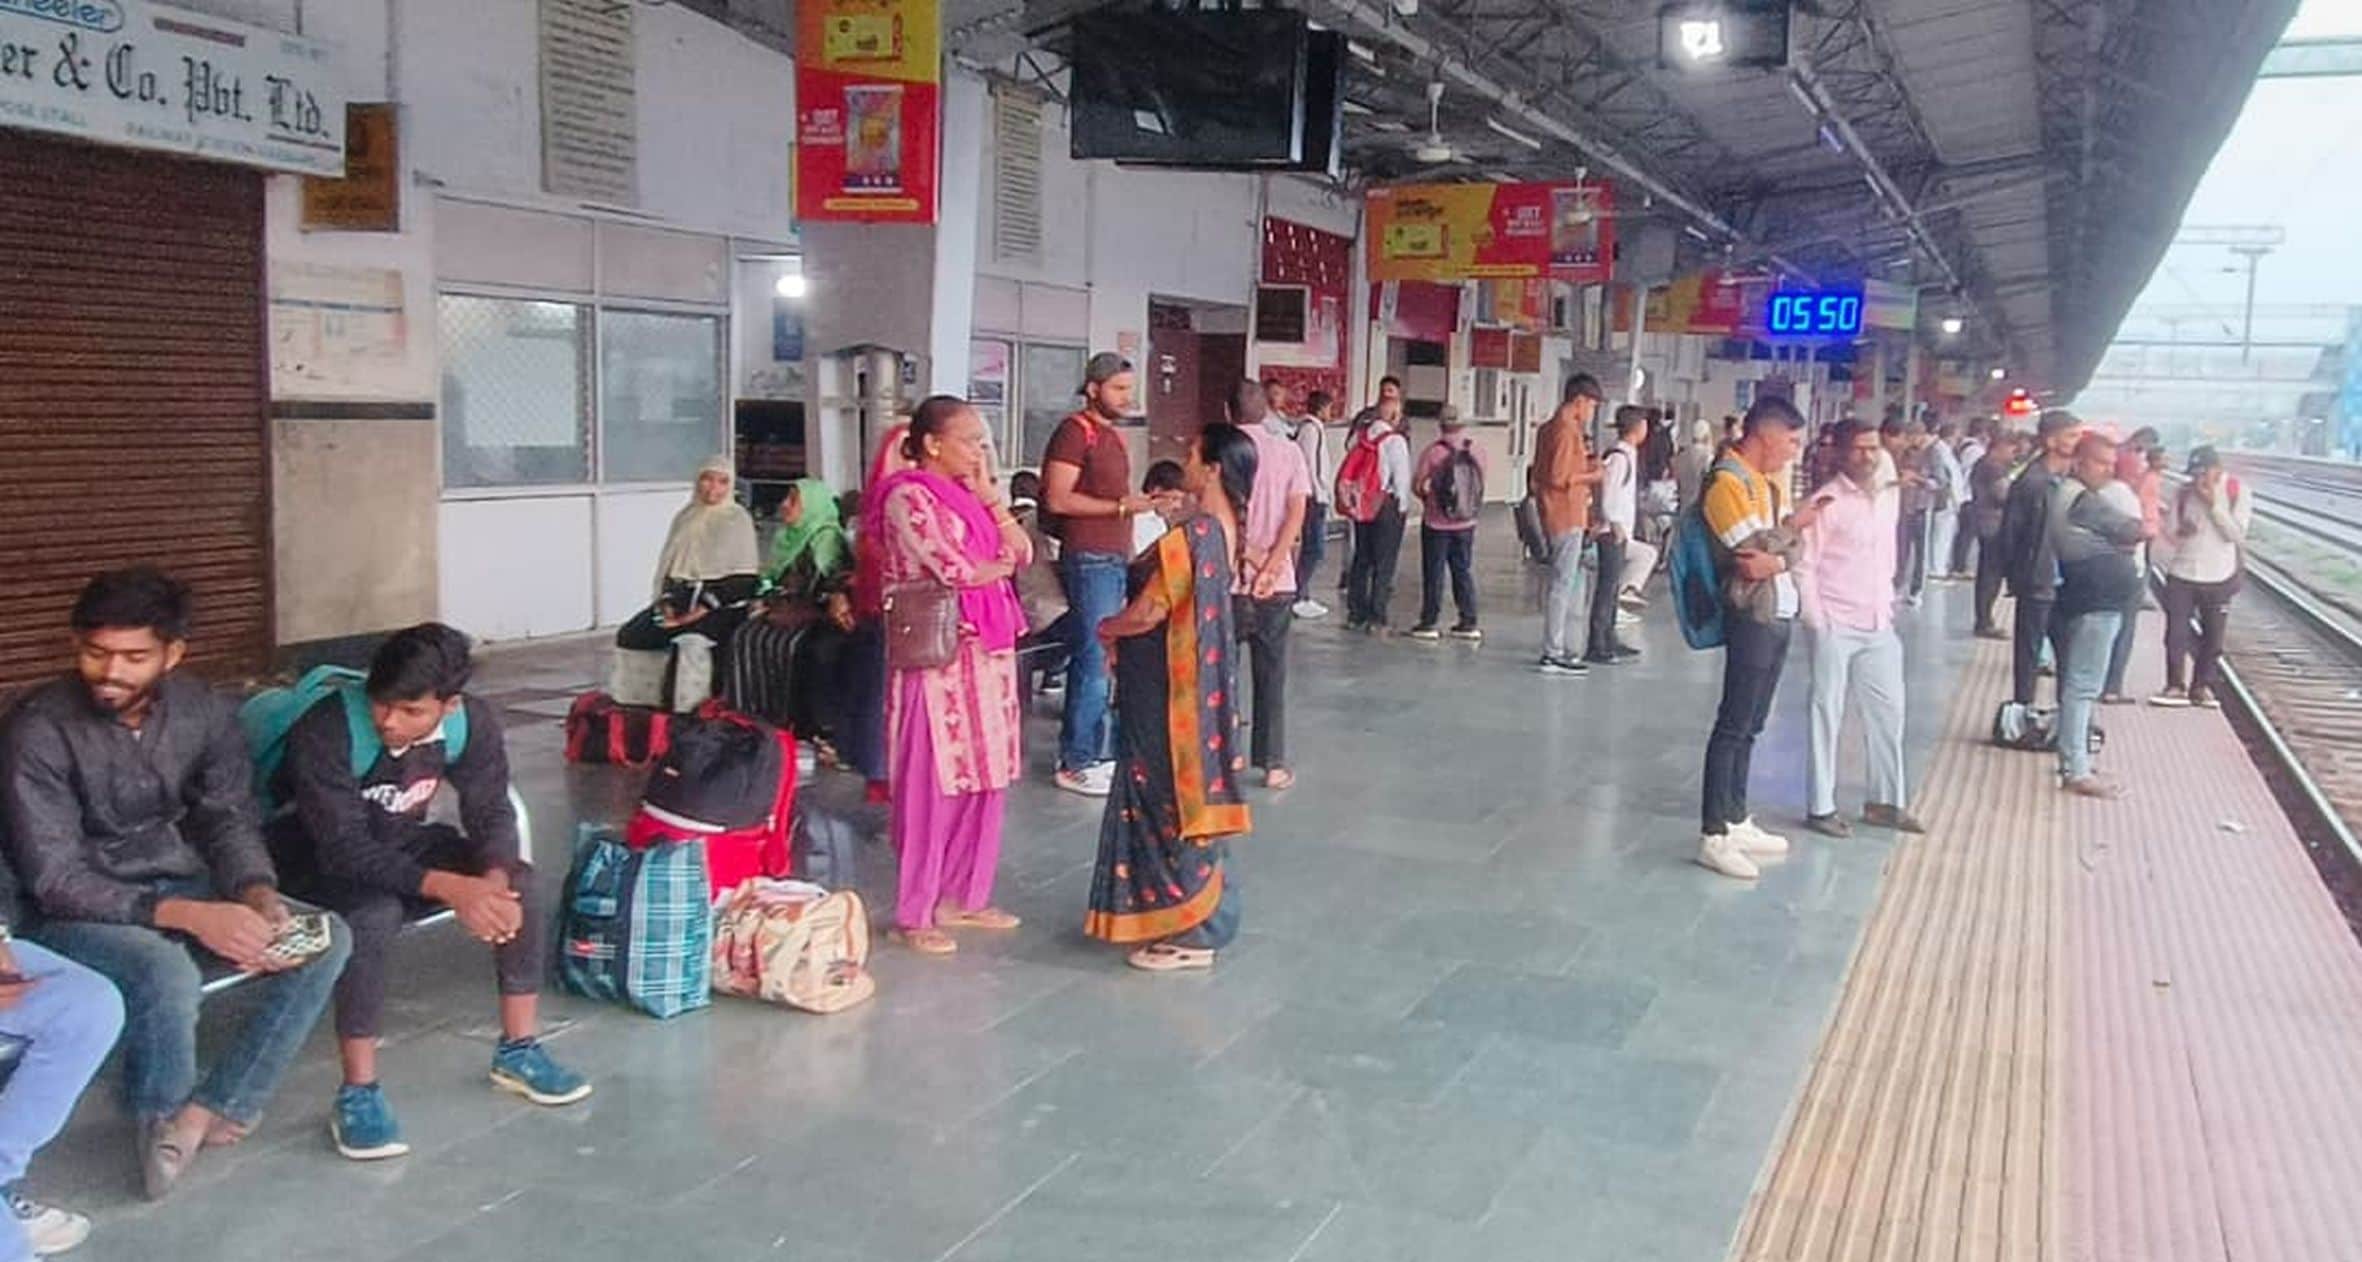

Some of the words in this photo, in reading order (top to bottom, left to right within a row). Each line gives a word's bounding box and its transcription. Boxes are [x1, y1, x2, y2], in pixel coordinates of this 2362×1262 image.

[53, 32, 90, 91] &
[105, 44, 167, 105] Co.
[182, 56, 251, 122] Pvt.
[265, 75, 329, 137] Ltd.
[1772, 297, 1812, 330] 05
[1818, 297, 1858, 330] 50
